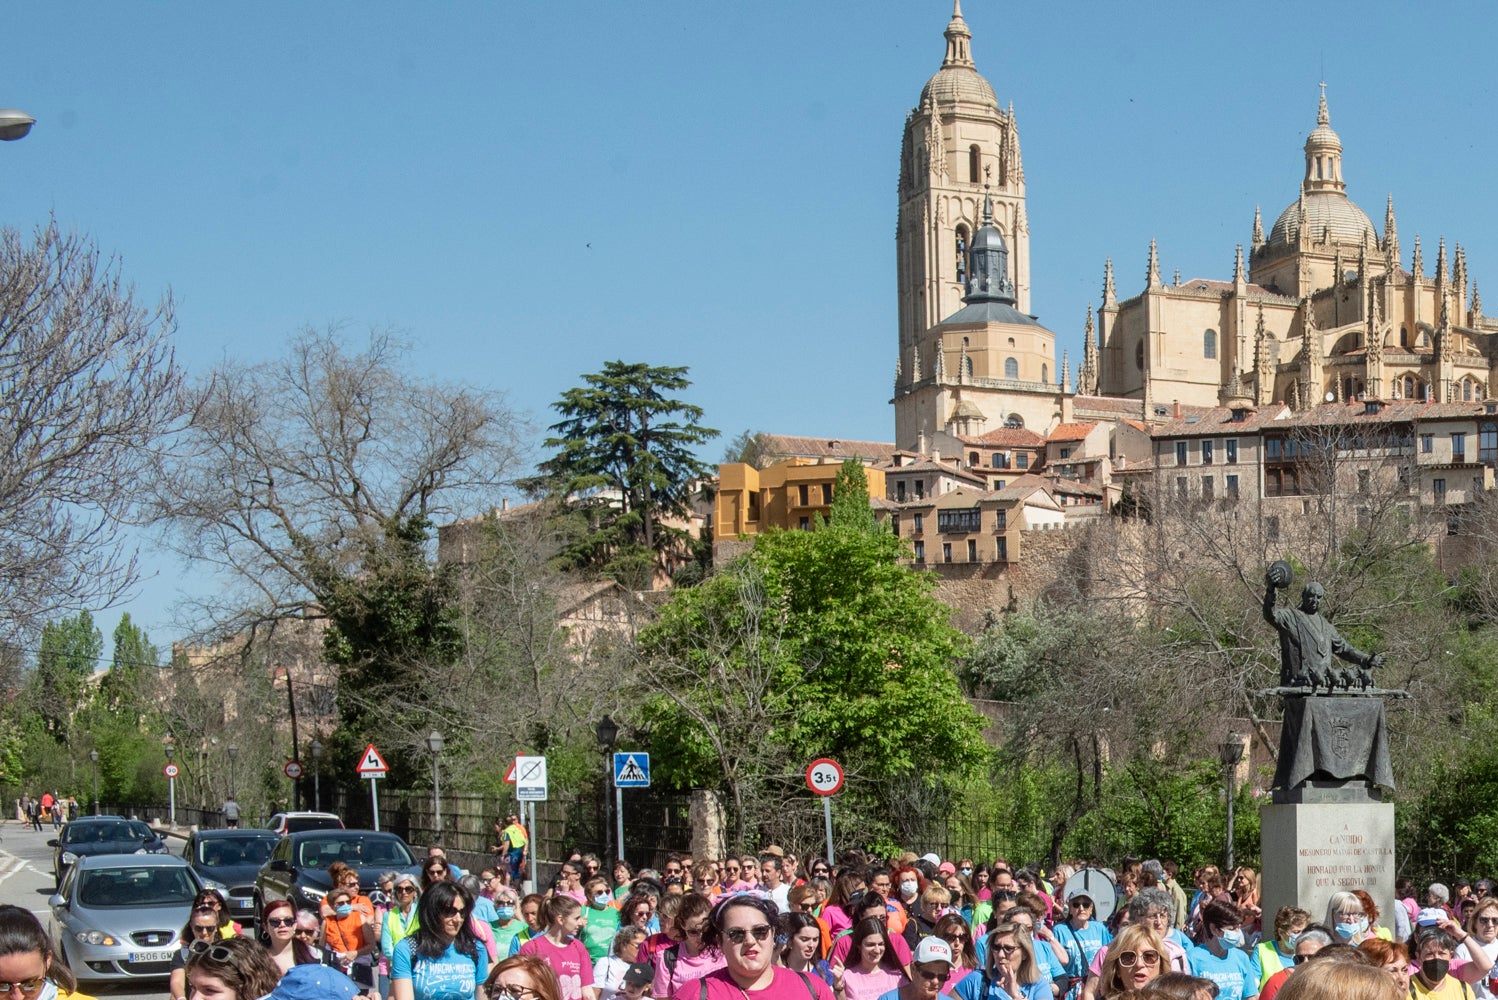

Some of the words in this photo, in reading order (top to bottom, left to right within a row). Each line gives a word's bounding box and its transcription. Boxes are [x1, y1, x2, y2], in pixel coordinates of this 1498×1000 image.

[1343, 823, 1349, 831] A
[1353, 848, 1361, 857] DE
[1339, 864, 1352, 875] POR
[1353, 864, 1363, 875] LA
[1315, 877, 1329, 887] QUE
[1338, 876, 1365, 887] SEGOVIA
[135, 952, 158, 961] 8506
